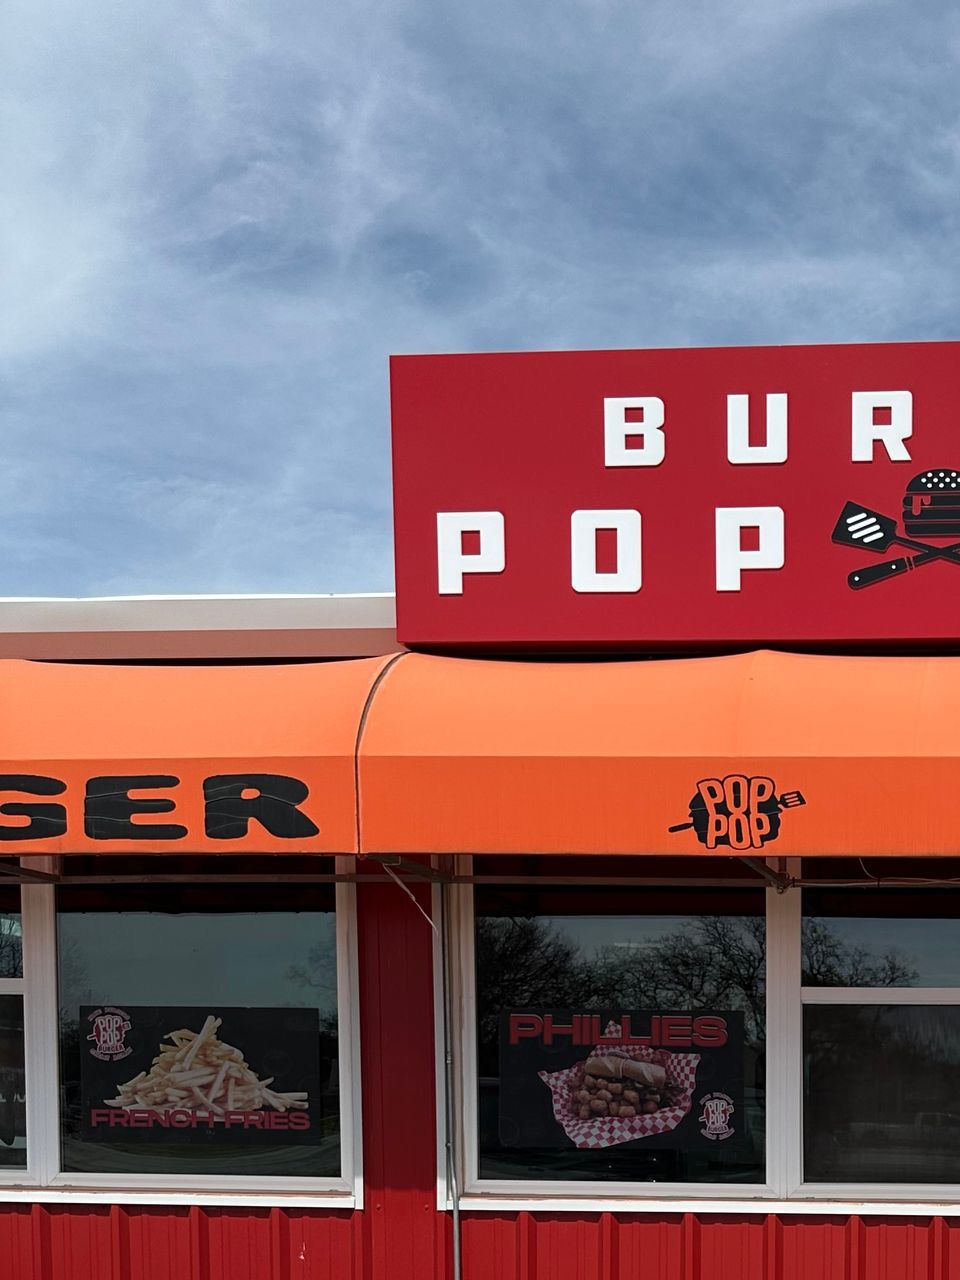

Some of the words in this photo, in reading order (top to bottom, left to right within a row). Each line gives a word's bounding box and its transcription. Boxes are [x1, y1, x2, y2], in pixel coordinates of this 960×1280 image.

[436, 506, 785, 595] POP
[696, 774, 776, 814] POP
[706, 811, 771, 849] POP
[97, 1016, 122, 1031] POP
[508, 1013, 729, 1048] PHILLIES
[100, 1030, 121, 1044] POP
[707, 1101, 726, 1114] POP
[89, 1108, 215, 1129] FRENCH
[225, 1109, 311, 1131] FRIES
[709, 1113, 725, 1126] POP
